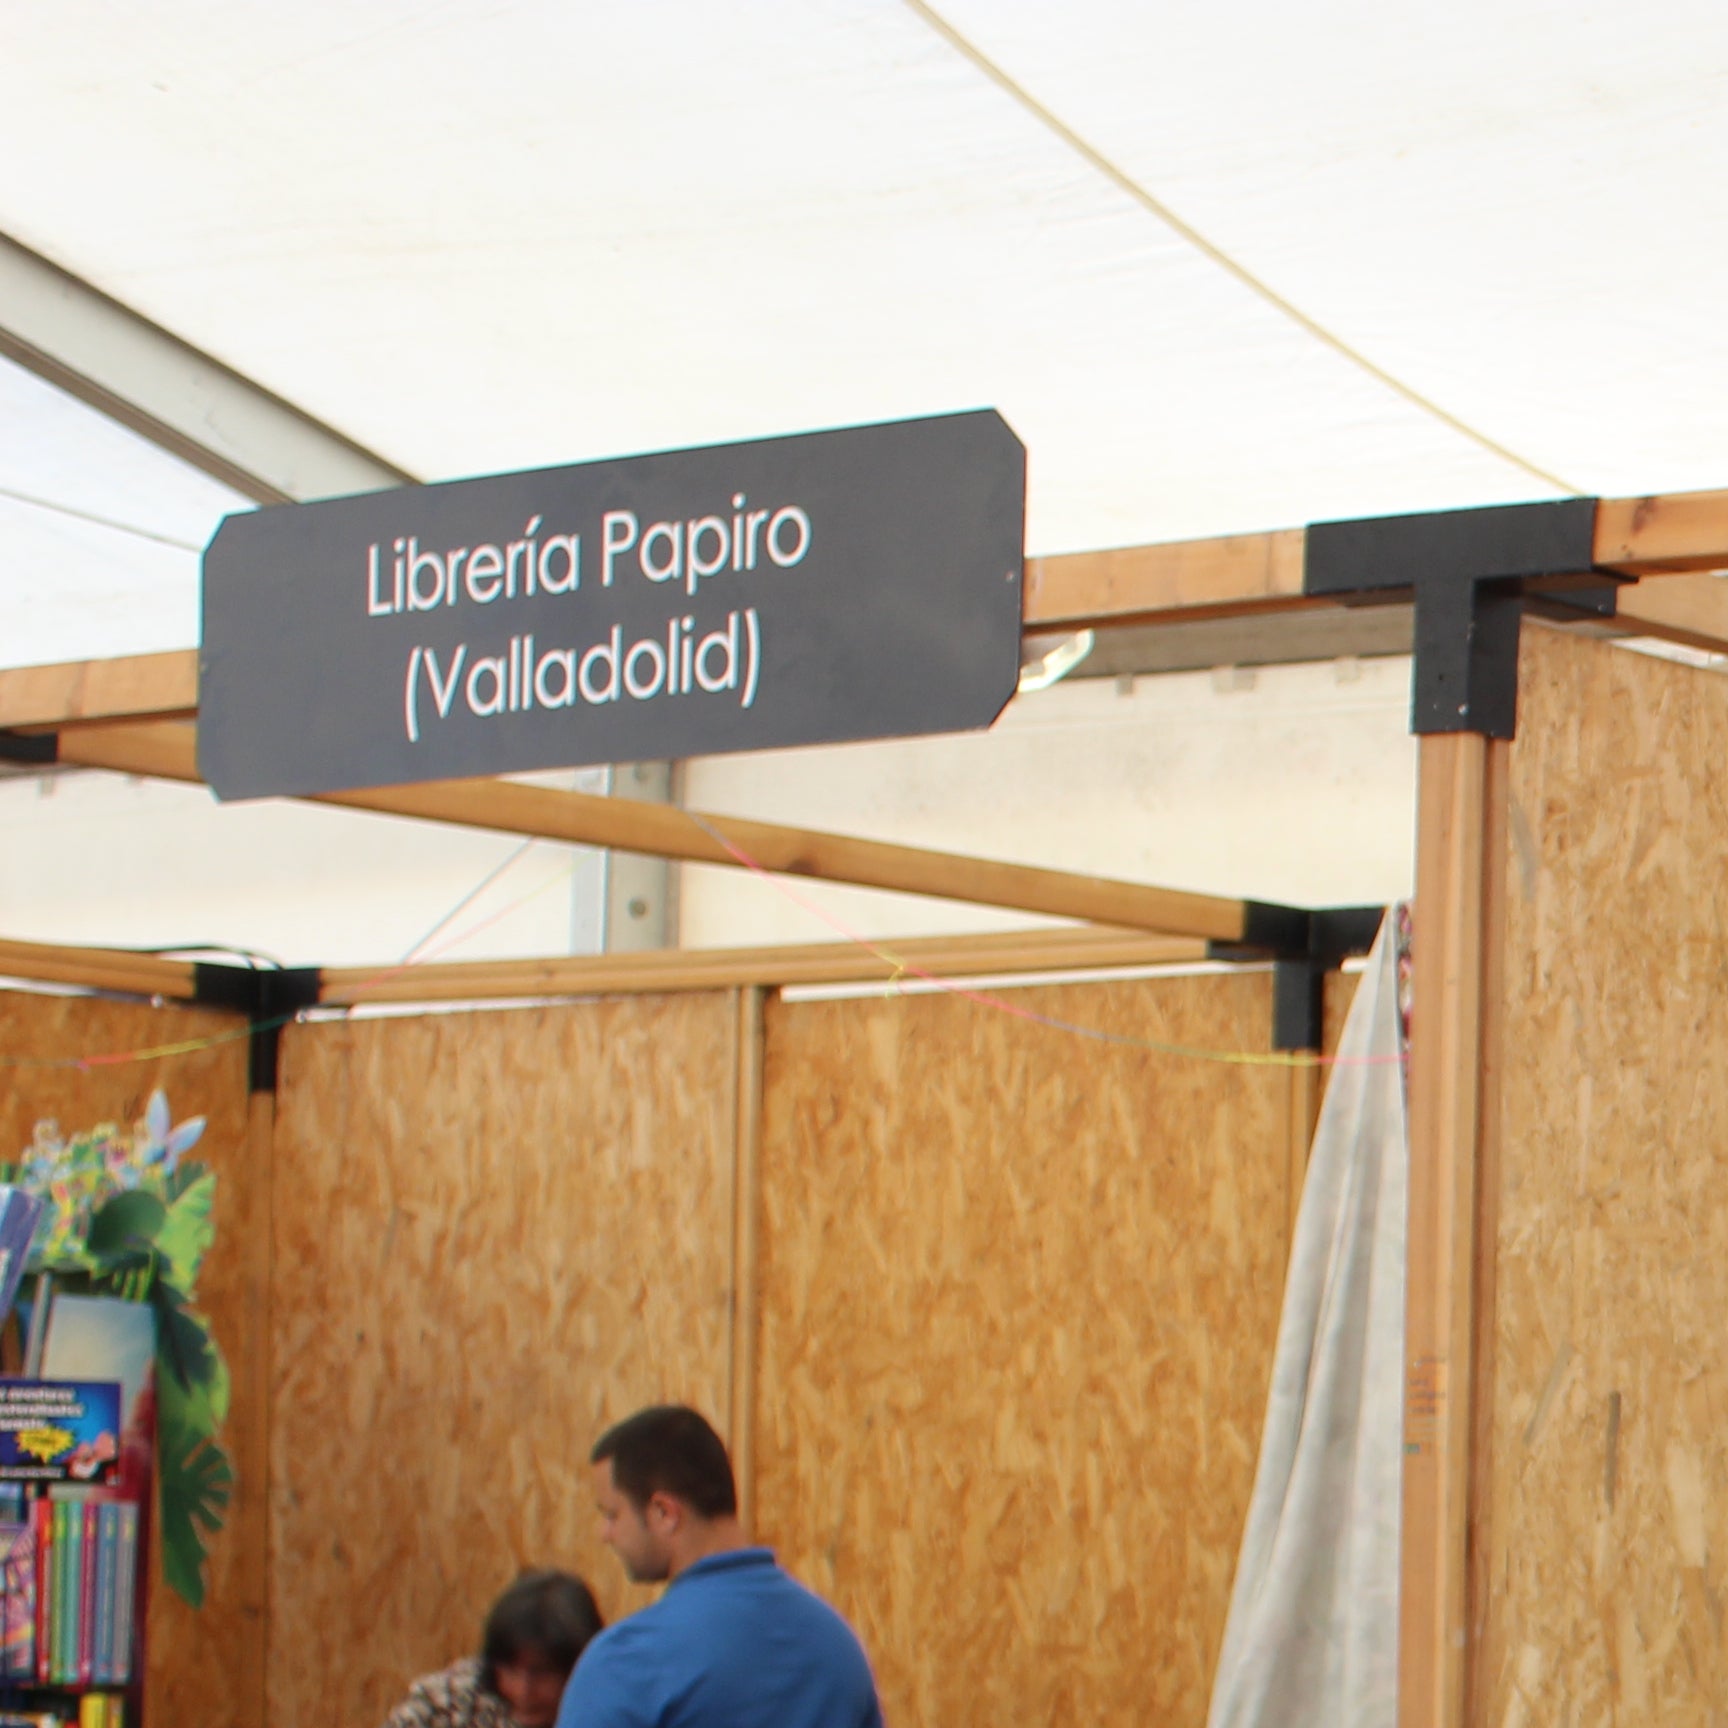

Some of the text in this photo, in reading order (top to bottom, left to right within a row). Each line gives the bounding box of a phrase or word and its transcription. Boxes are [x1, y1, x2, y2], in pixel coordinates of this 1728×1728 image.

[368, 493, 810, 616] Librería Papiro
[405, 609, 759, 742] (Valladolid)
